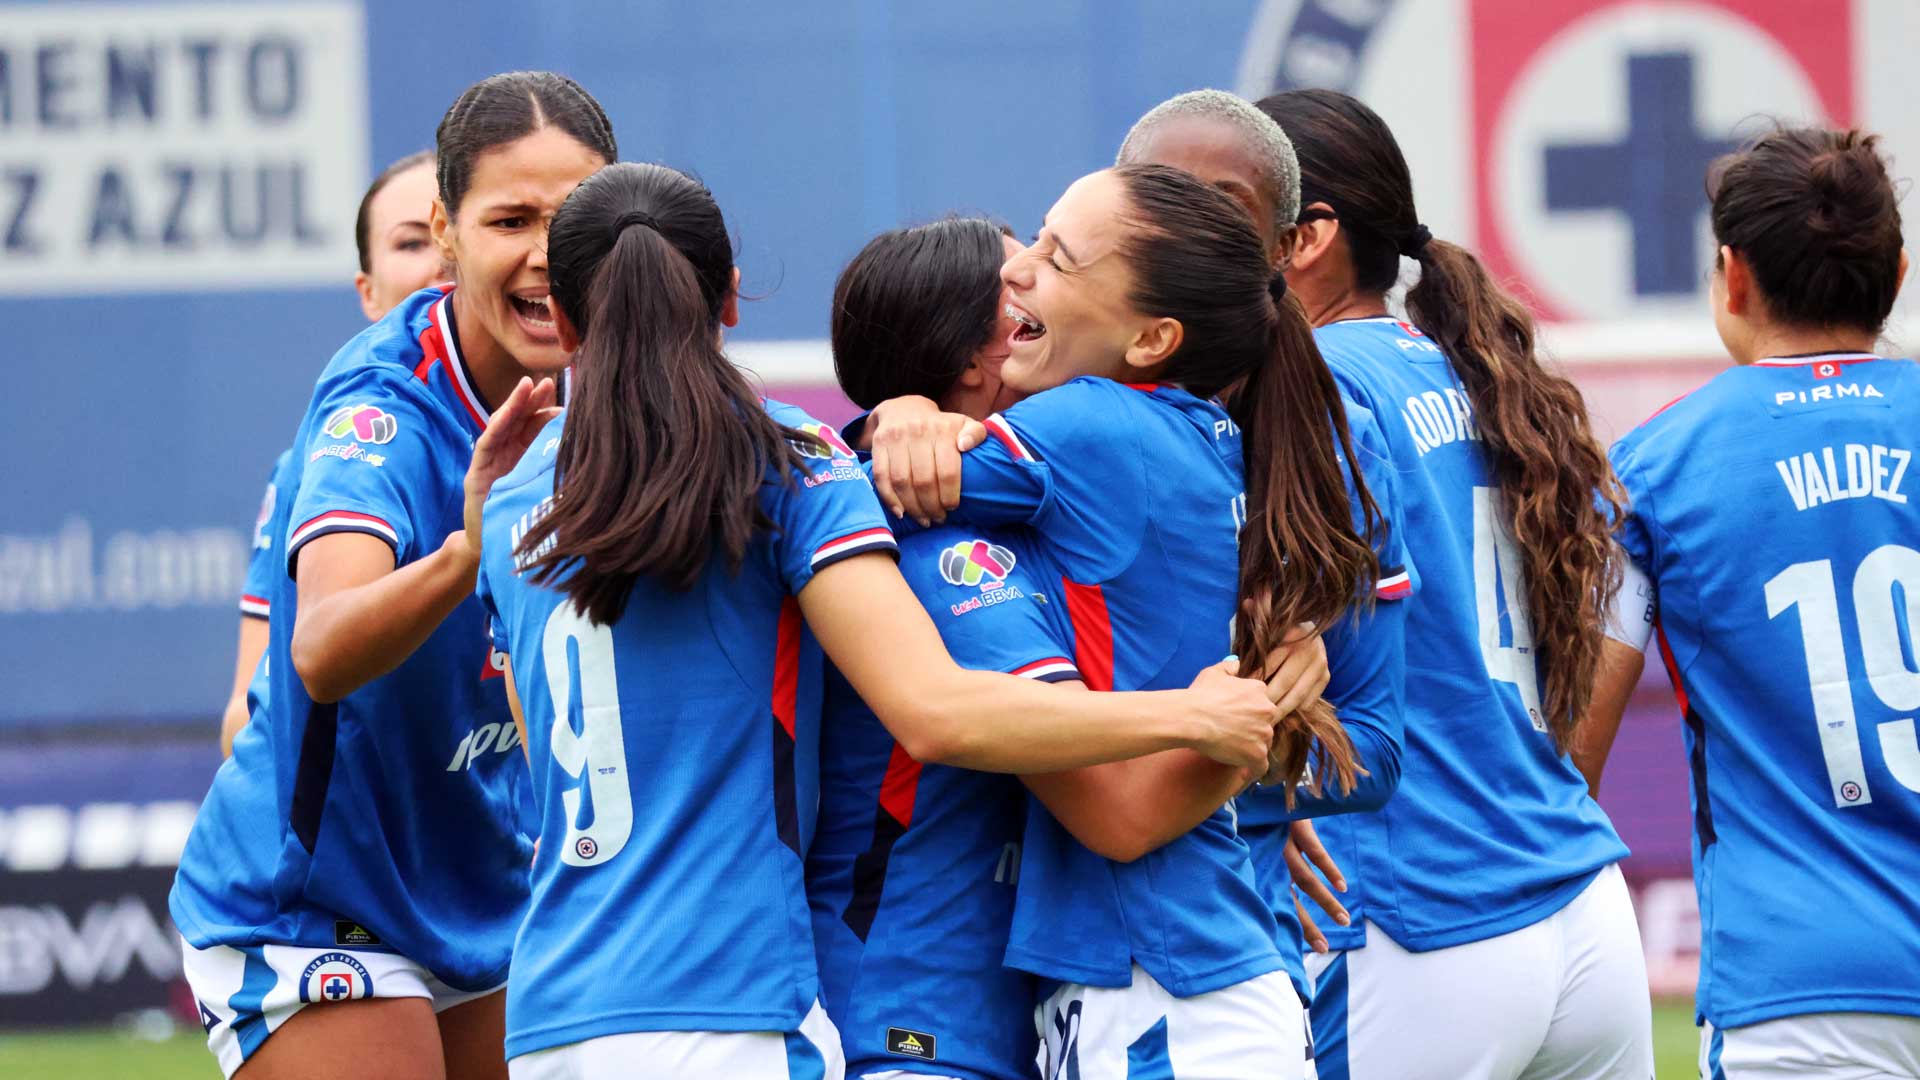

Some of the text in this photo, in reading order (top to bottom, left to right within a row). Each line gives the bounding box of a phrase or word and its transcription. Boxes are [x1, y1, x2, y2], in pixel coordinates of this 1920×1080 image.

[0, 36, 304, 127] ENTO
[84, 162, 331, 252] AZUL
[1775, 383, 1884, 406] PIRMA
[1775, 443, 1912, 512] VALDEZ
[981, 586, 1025, 607] BBVA
[1472, 486, 1549, 735] 4
[1763, 543, 1920, 808] 19
[542, 598, 634, 868] 9
[304, 954, 368, 979] CLUB DE FUTBOL
[897, 1042, 925, 1053] PIRMA
